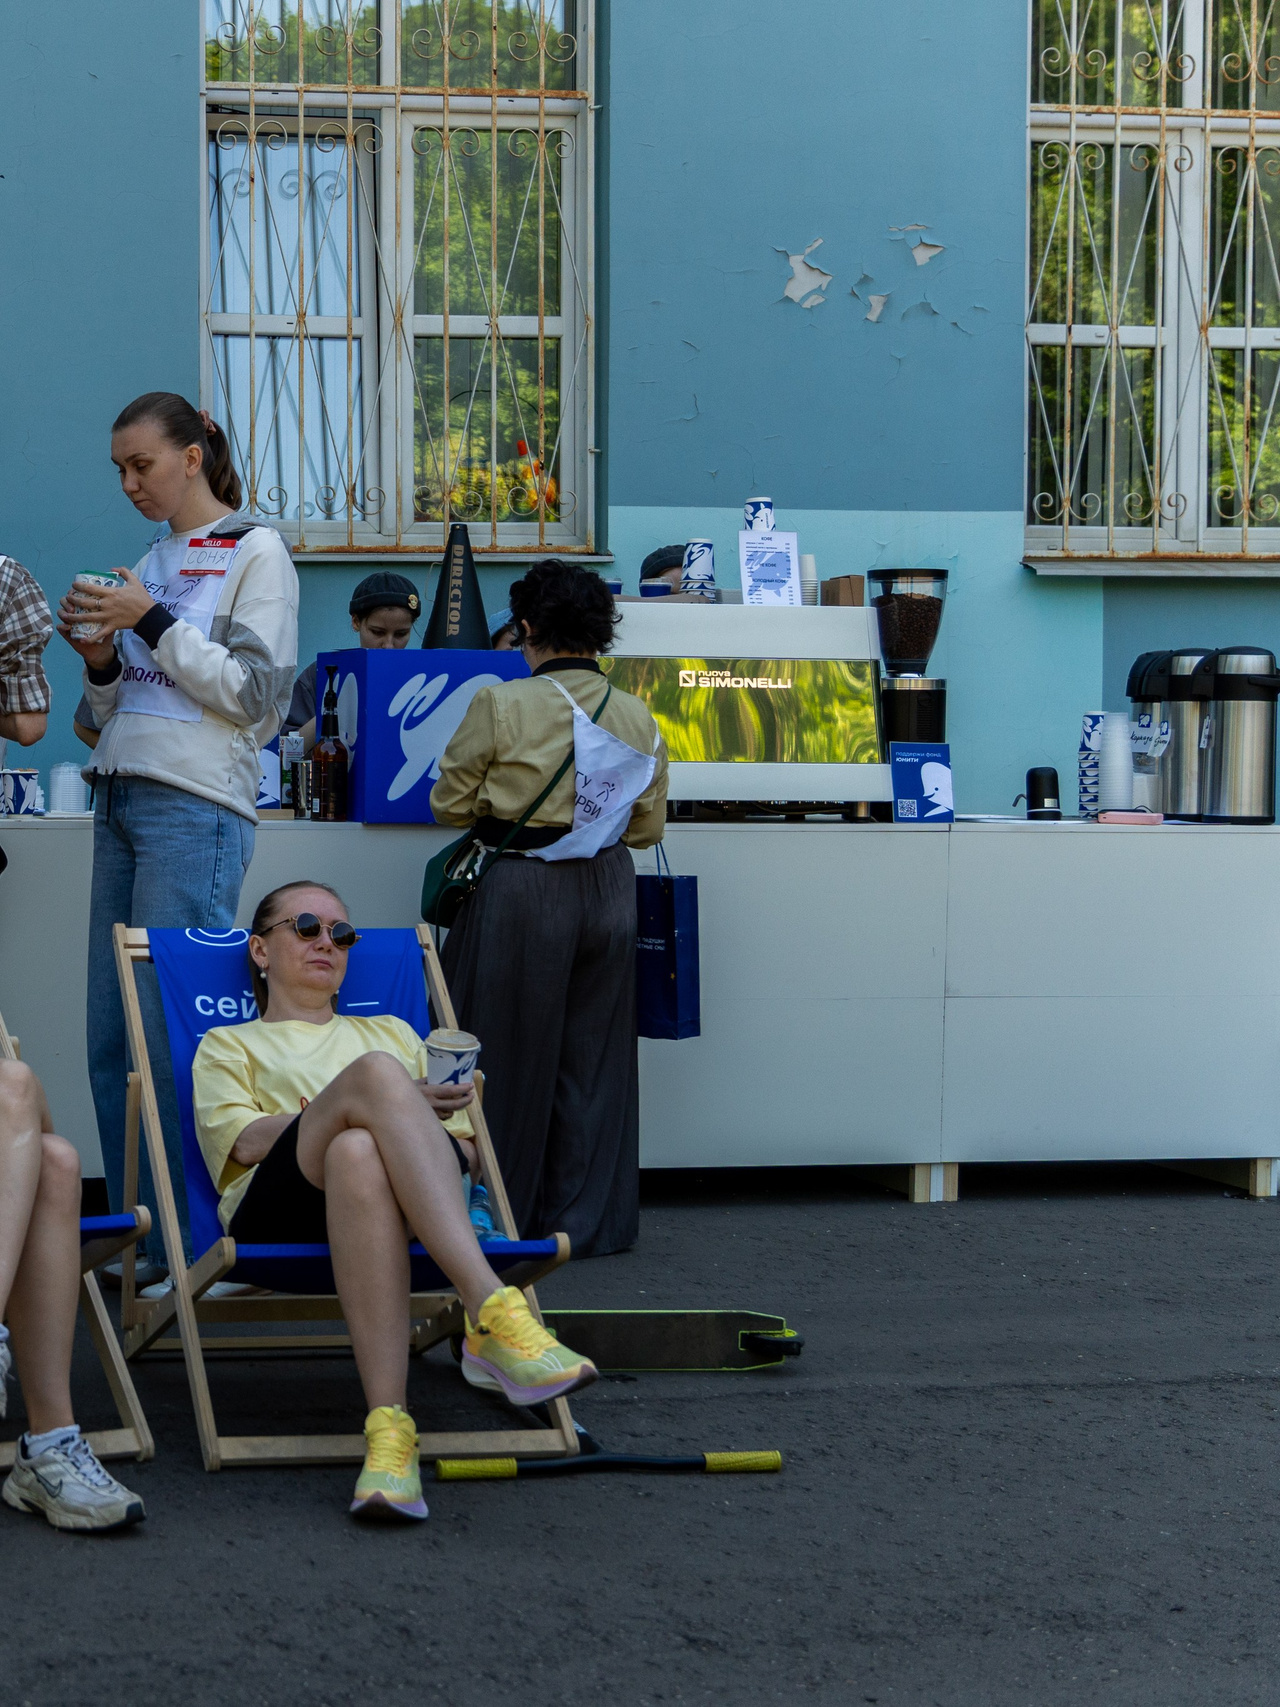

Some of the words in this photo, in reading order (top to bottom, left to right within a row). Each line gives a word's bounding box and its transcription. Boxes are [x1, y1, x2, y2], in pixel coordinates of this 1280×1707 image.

[187, 550, 229, 564] СОНЯ
[448, 544, 465, 636] DIRECTOR
[122, 665, 177, 689] ОЛОНТЕ
[698, 677, 792, 689] SIMONELLI
[574, 770, 592, 789] ГУ
[195, 990, 262, 1019] сей
